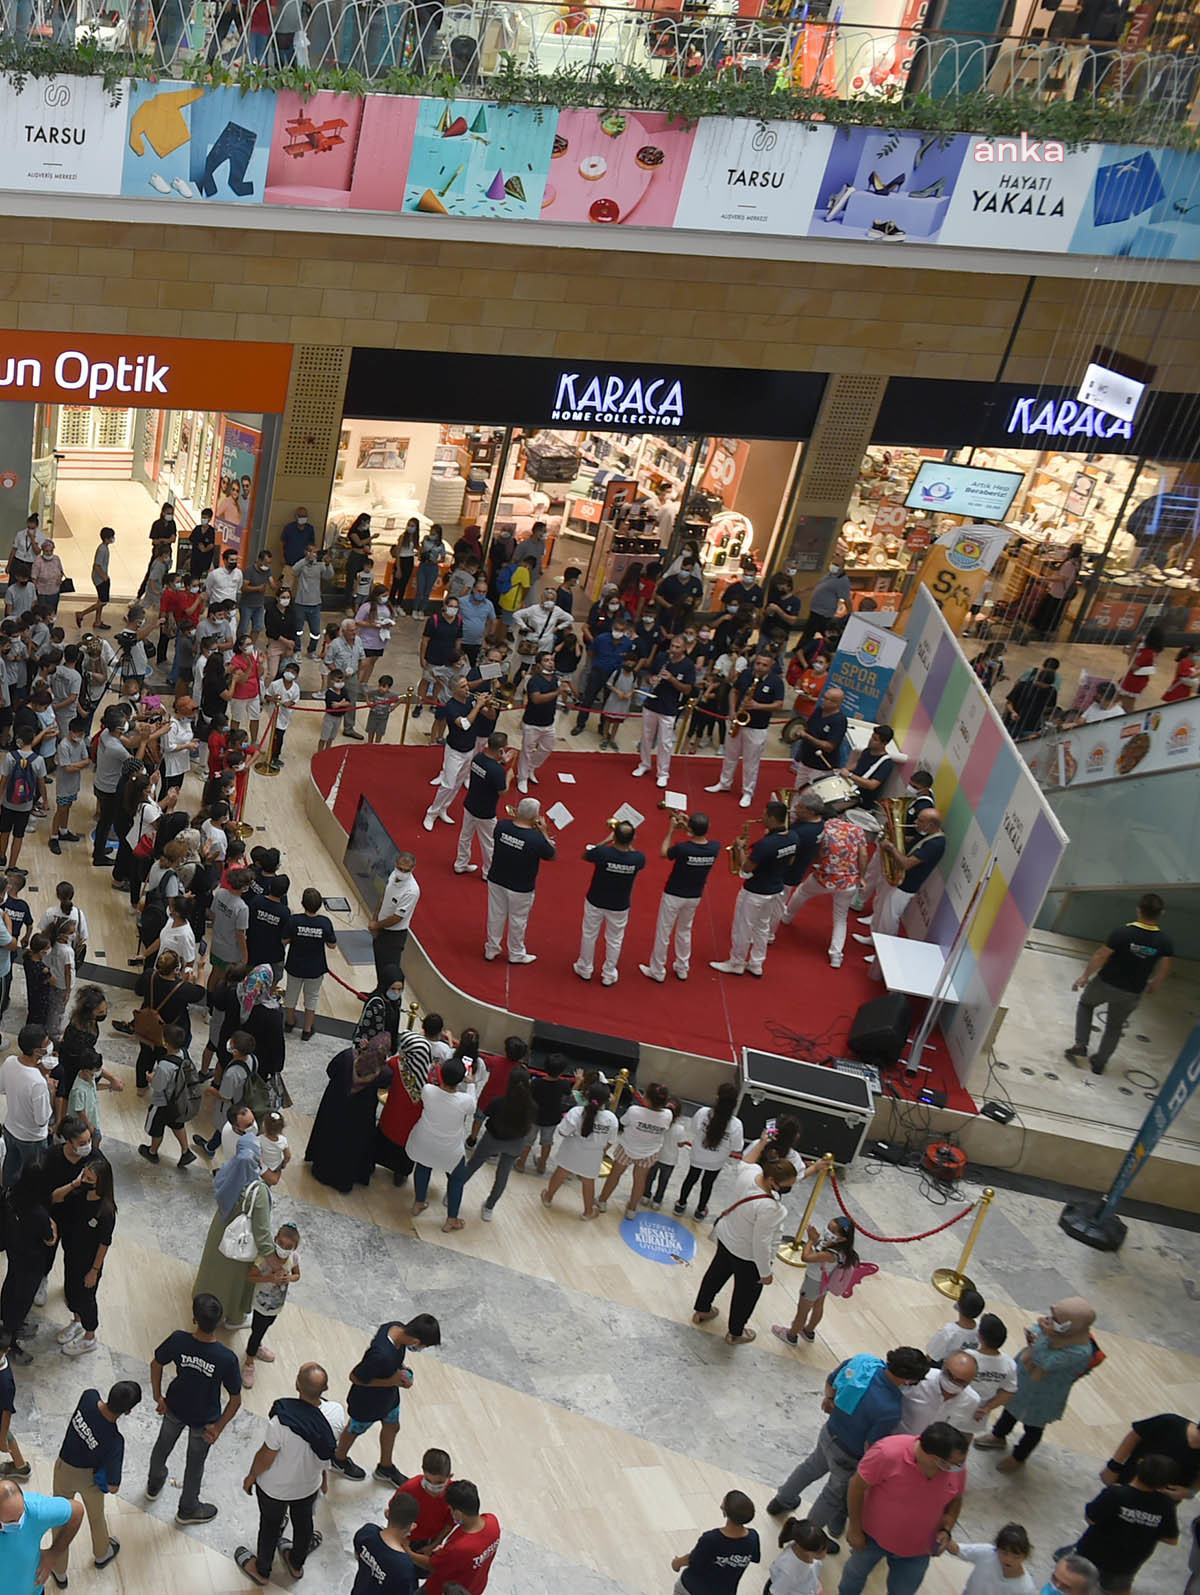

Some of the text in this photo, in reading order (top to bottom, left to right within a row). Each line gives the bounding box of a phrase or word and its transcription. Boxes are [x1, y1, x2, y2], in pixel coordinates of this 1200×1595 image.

[25, 125, 85, 145] TARSU
[727, 169, 785, 189] TARSU
[999, 174, 1052, 191] HAYATI
[972, 190, 1064, 217] YAKALA
[54, 350, 169, 399] Optik
[555, 373, 684, 416] KARACA
[551, 410, 681, 426] HOME COLLECTION
[875, 506, 907, 527] 50
[841, 661, 878, 686] SPOR
[501, 832, 525, 846] TARSUS
[297, 925, 323, 936] TARSUS
[181, 1354, 216, 1373] TARSUS
[74, 1410, 100, 1449] TARSUS
[1120, 1506, 1163, 1522] TARSUS
[361, 1545, 387, 1581] TARSUS
